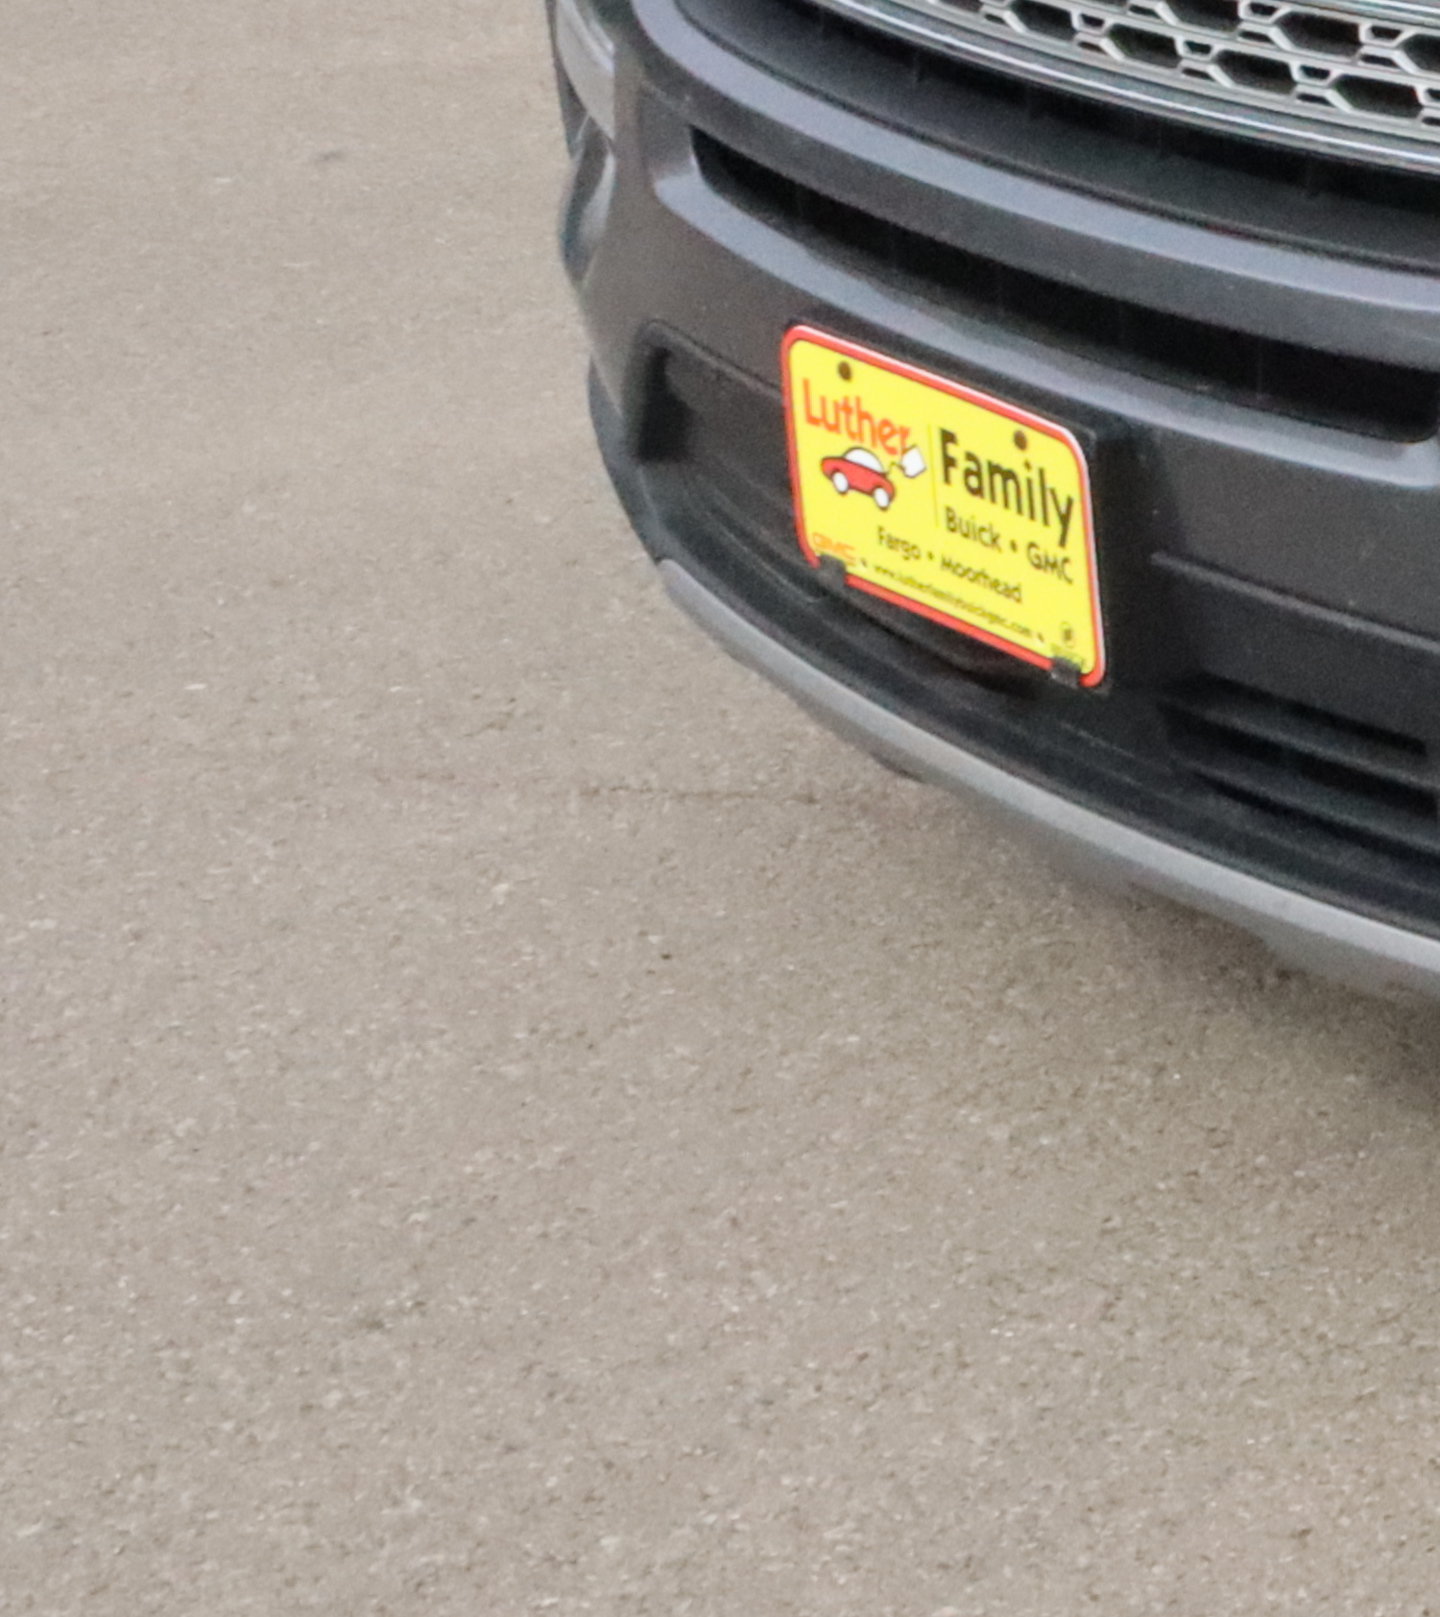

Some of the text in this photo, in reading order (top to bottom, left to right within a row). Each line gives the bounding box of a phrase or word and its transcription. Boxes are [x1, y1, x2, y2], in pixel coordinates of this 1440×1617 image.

[803, 377, 910, 456] Luther
[939, 427, 1074, 549] Family
[877, 524, 1022, 605] Fargo Moorhead
[945, 505, 1073, 585] Buick GMC
